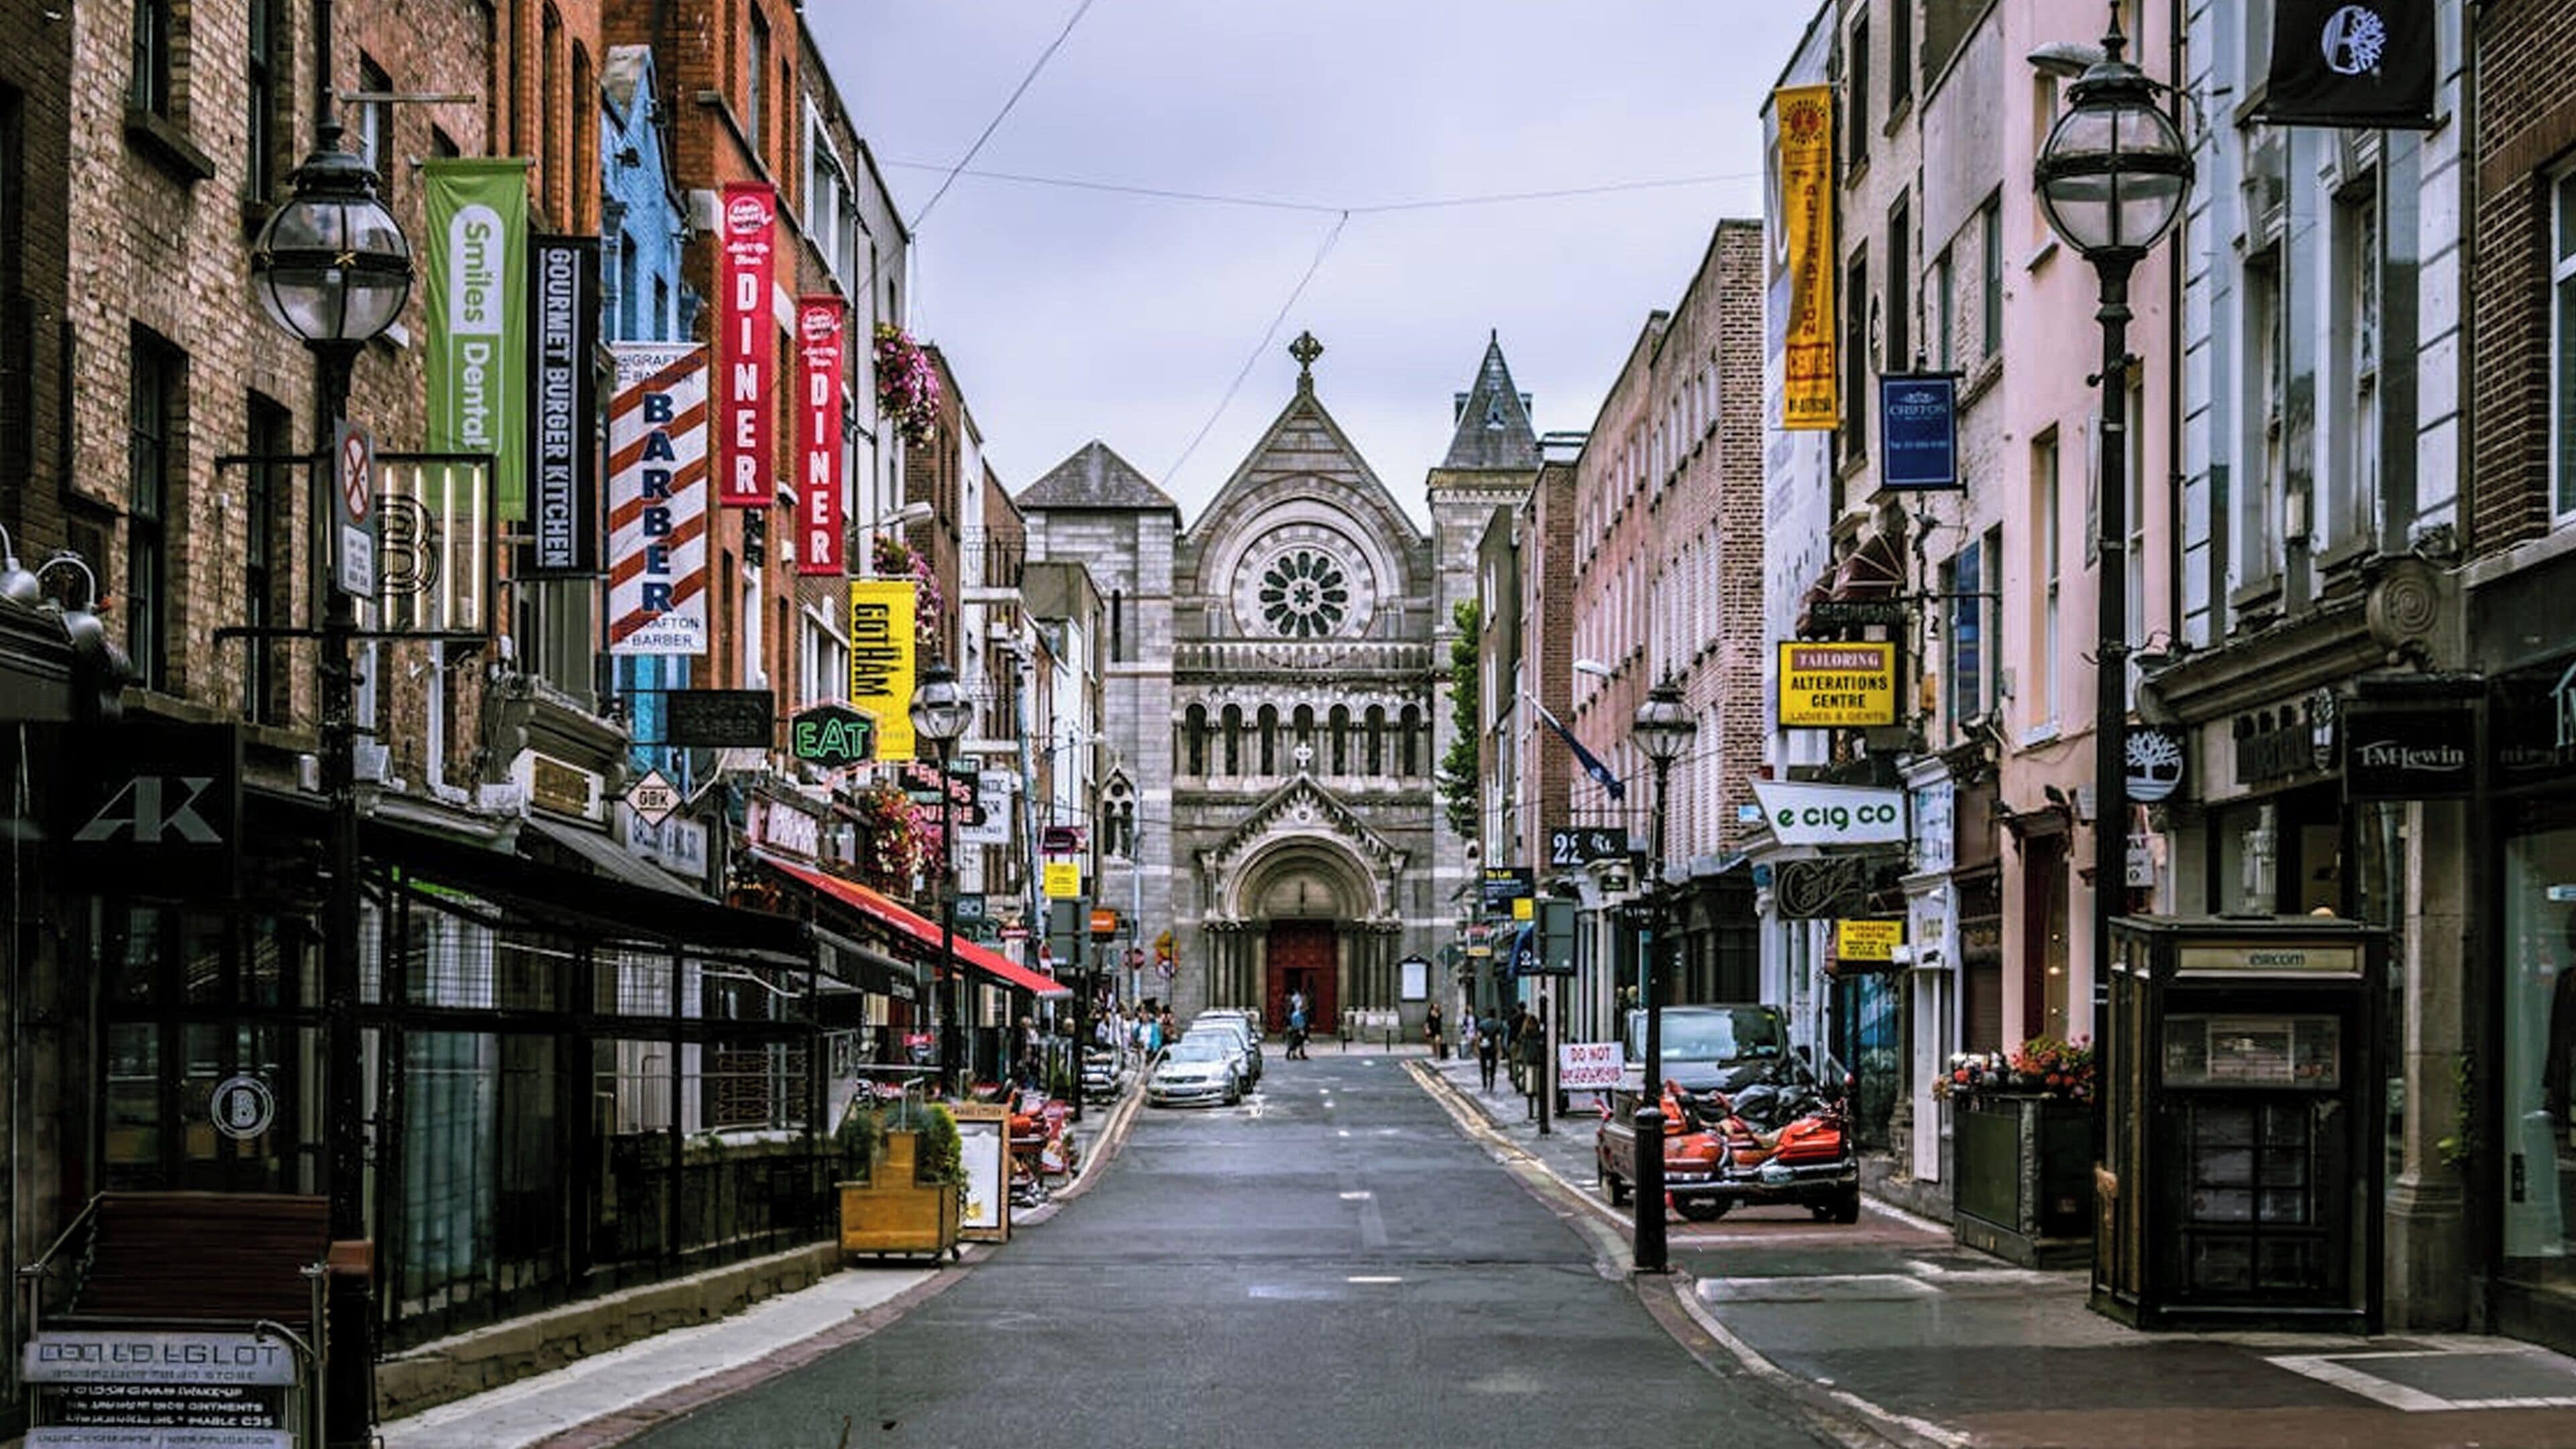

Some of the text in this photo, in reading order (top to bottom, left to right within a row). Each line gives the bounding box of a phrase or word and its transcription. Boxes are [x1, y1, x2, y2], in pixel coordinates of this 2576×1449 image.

[463, 221, 491, 448] Smiles Dental
[545, 248, 572, 566] GOURMET BURGER KITCHEN
[734, 273, 759, 494] DINER
[641, 392, 676, 613] BARBER
[810, 373, 830, 564] DINER
[855, 604, 903, 696] GOTHAM
[1791, 676, 1888, 690] ALTERATIONS
[1799, 653, 1879, 667] TAILORING
[796, 717, 869, 759] EAT
[1812, 694, 1866, 708] CENTRE
[72, 775, 223, 843] AK
[1778, 804, 1896, 832] e cig co
